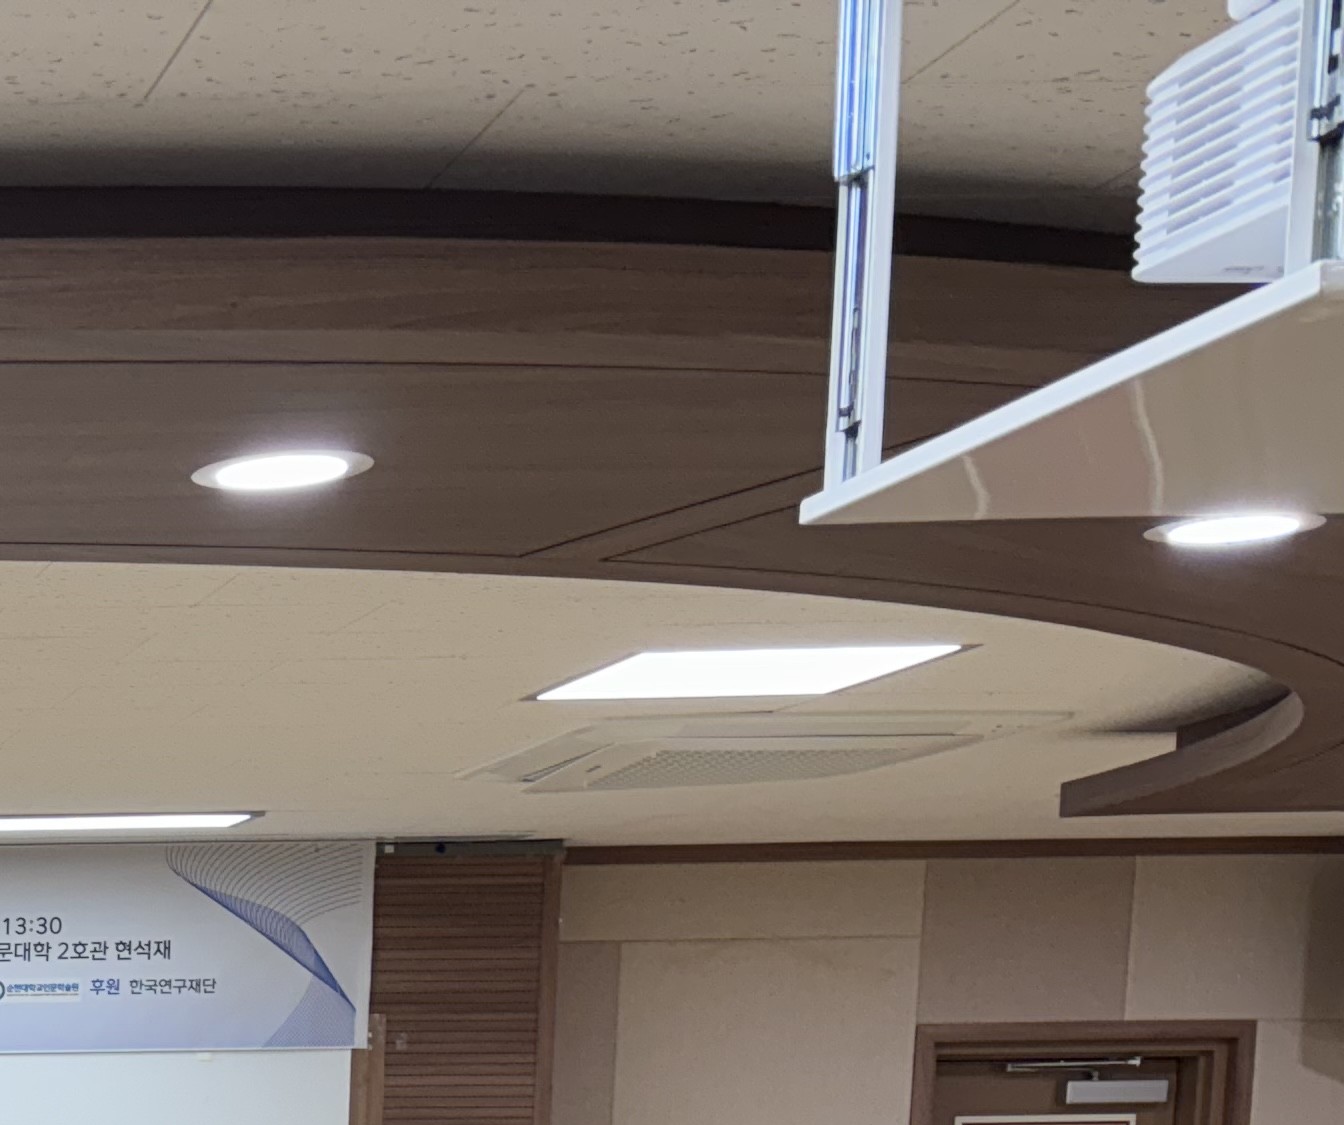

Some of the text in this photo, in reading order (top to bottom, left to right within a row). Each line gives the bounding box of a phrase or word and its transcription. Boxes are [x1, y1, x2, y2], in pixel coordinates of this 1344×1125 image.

[3, 916, 63, 936] 13:30
[57, 940, 109, 961] 2호관
[114, 939, 172, 961] 현석재
[89, 977, 217, 996] 후원 한국연구재단
